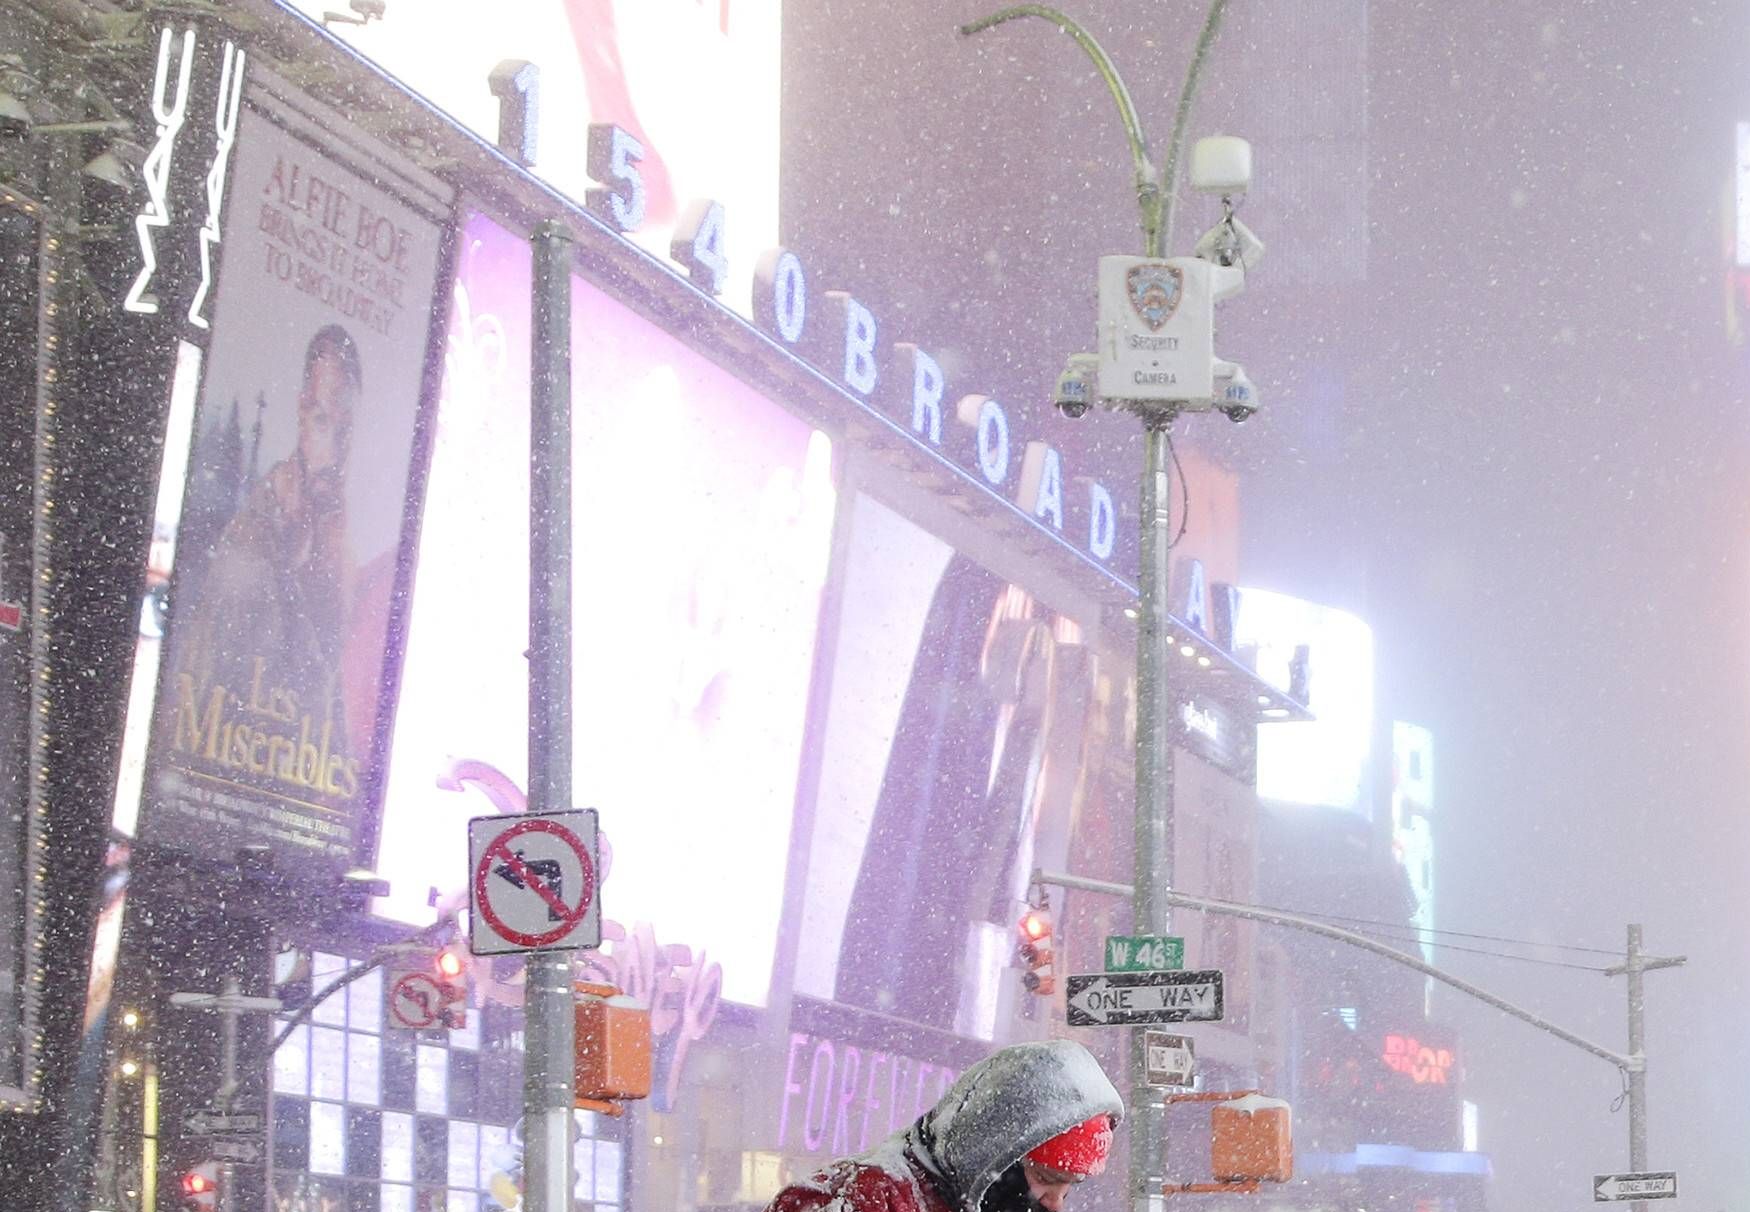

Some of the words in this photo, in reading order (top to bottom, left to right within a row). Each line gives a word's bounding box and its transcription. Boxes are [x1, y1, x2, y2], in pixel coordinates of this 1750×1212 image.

[263, 155, 349, 240] ALFIE
[499, 58, 806, 344] 1540
[265, 242, 292, 281] TO
[246, 655, 298, 722] Les
[1111, 943, 1129, 967] W
[1135, 942, 1166, 968] 46
[1087, 989, 1133, 1011] ONE
[1160, 987, 1208, 1008] WAY
[778, 1032, 956, 1155] FOREVE
[1618, 1181, 1641, 1193] ONE
[1644, 1180, 1667, 1191] WAY
